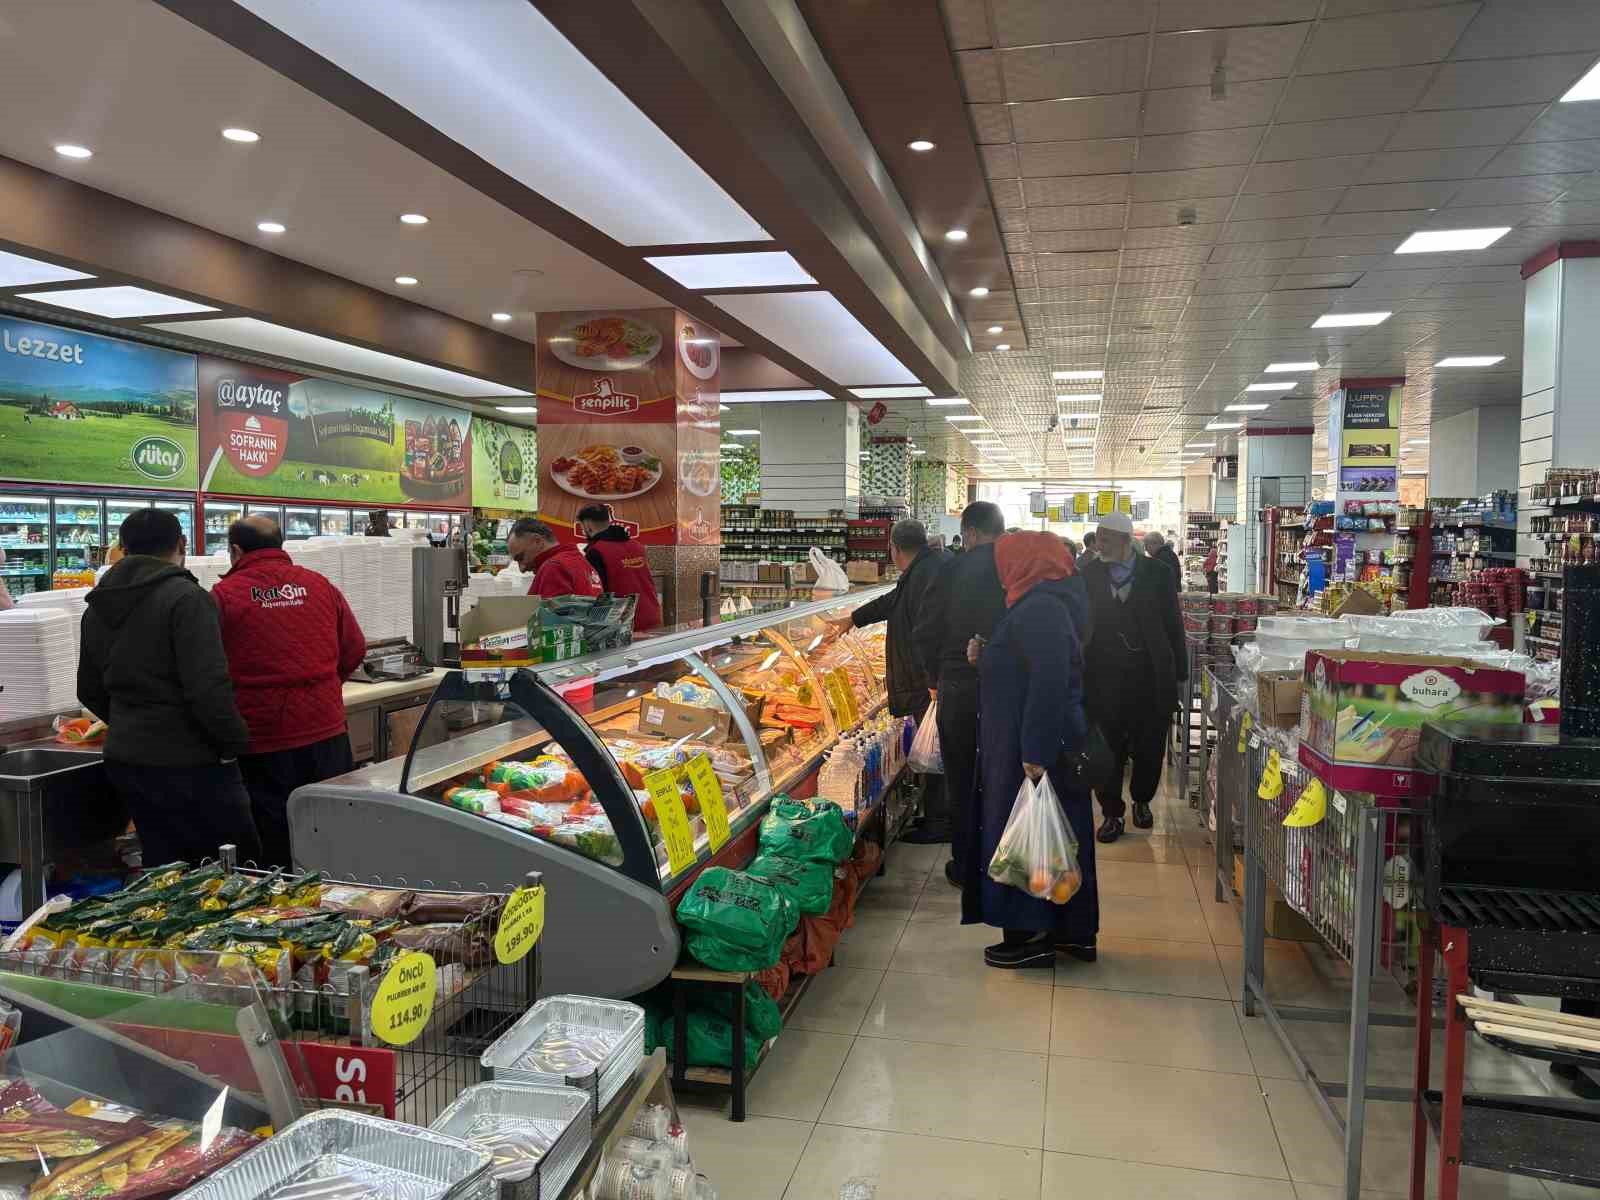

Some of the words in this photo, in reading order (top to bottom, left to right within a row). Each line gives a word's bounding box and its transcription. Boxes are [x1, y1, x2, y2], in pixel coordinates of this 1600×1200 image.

[3, 329, 84, 364] Lezzet
[230, 433, 277, 449] SOFRANIN
[240, 449, 267, 464] HAKKI
[1412, 685, 1448, 697] buhara
